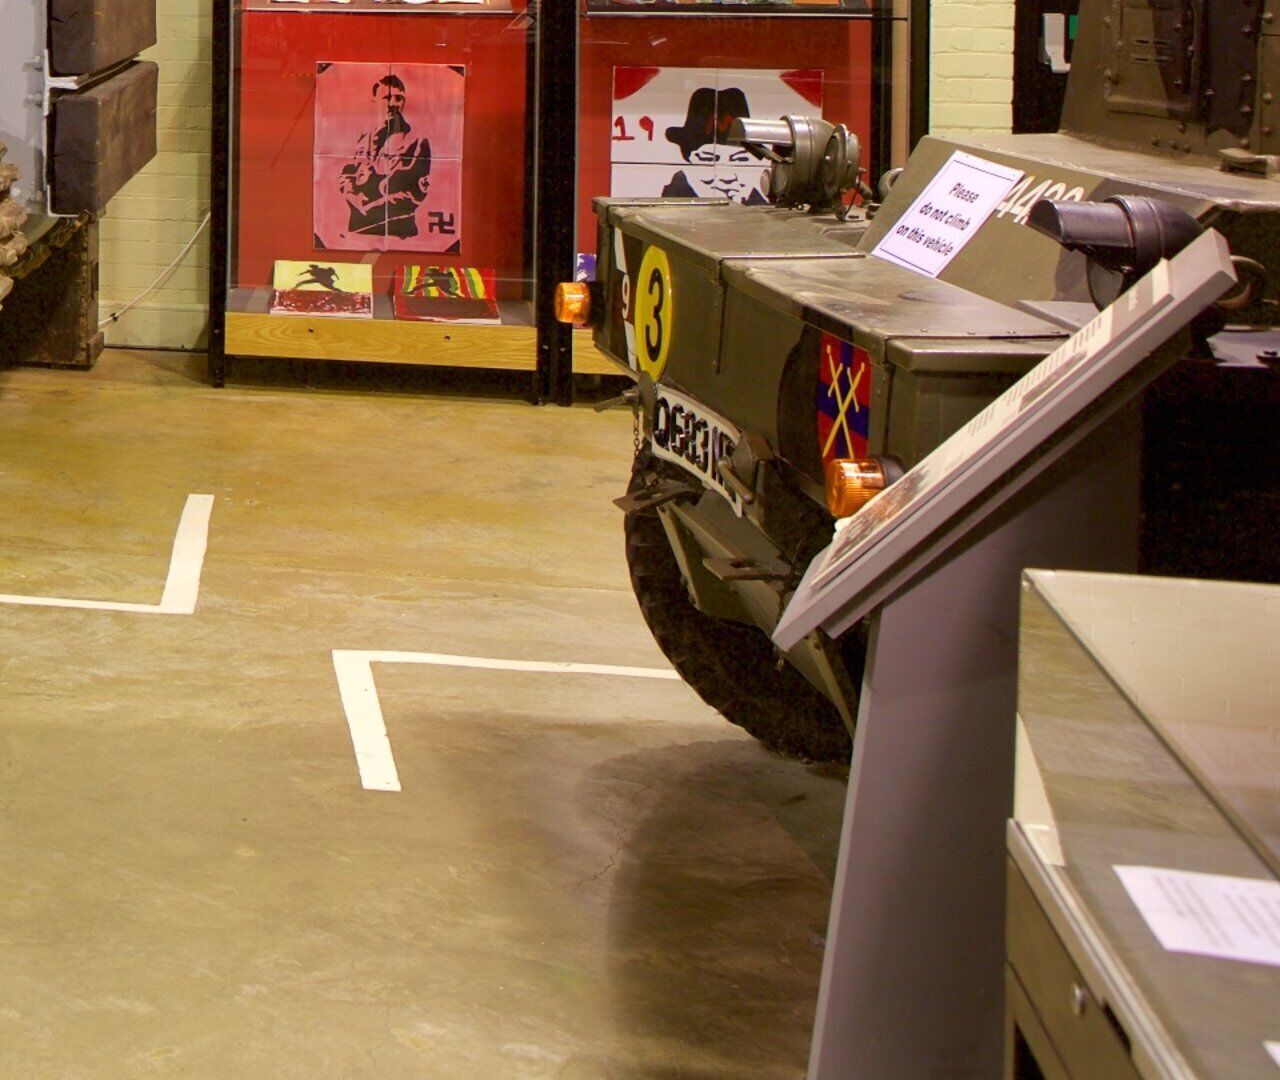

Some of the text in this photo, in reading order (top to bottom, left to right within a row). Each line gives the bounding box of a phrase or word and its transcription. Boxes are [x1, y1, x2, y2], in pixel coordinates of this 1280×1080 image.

[949, 182, 980, 204] Please
[919, 202, 971, 232] do not climb
[896, 224, 954, 256] on this vehicle
[645, 266, 665, 363] 3
